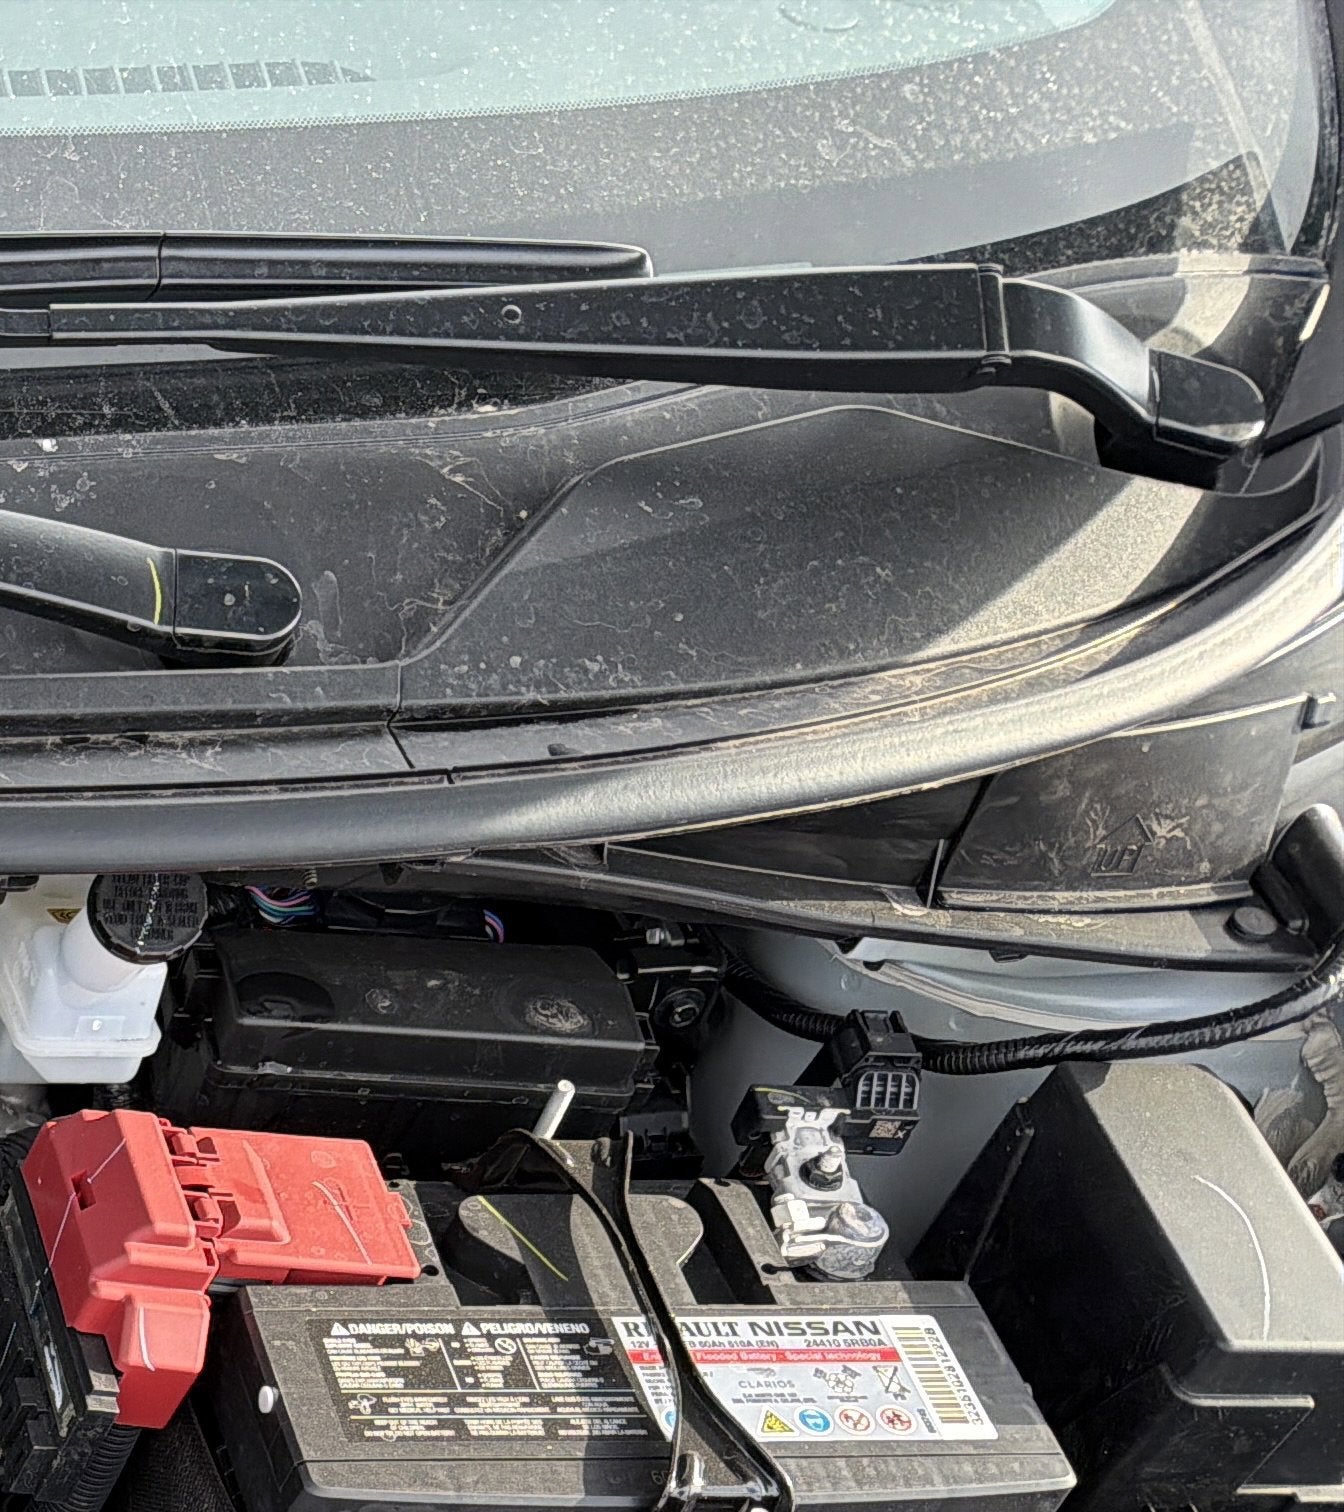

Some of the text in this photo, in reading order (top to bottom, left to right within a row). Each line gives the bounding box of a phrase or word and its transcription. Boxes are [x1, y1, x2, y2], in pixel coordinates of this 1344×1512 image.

[348, 1322, 455, 1335] DANGER/POISON
[480, 1322, 590, 1335] PELIGRO/VENENO
[621, 1320, 882, 1337] RAULT NISSAN
[803, 1339, 842, 1348] 24410
[737, 1380, 796, 1389] CLARIOS
